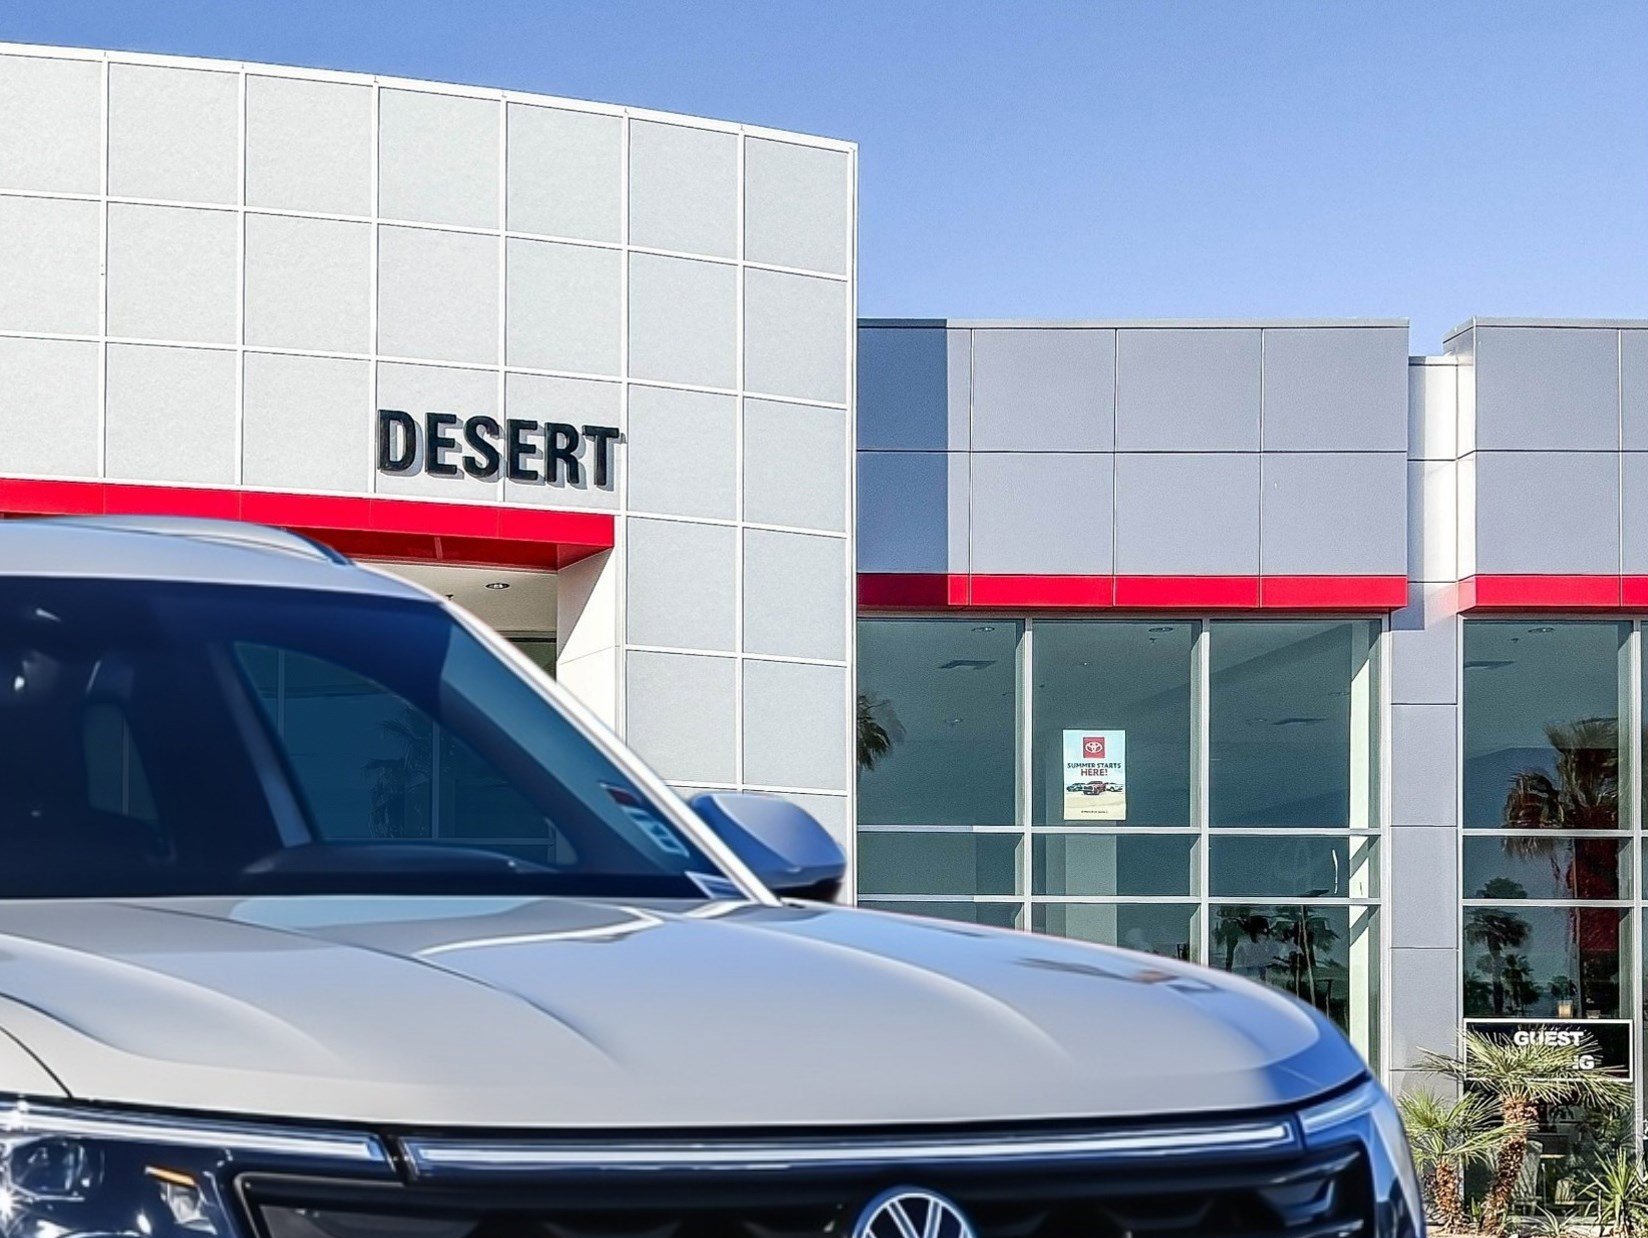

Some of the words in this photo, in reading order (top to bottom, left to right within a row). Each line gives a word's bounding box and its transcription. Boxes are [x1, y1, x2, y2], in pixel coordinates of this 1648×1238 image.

[377, 409, 620, 487] DESERT
[1080, 768, 1108, 777] HERE!
[1513, 1031, 1584, 1047] GUEST
